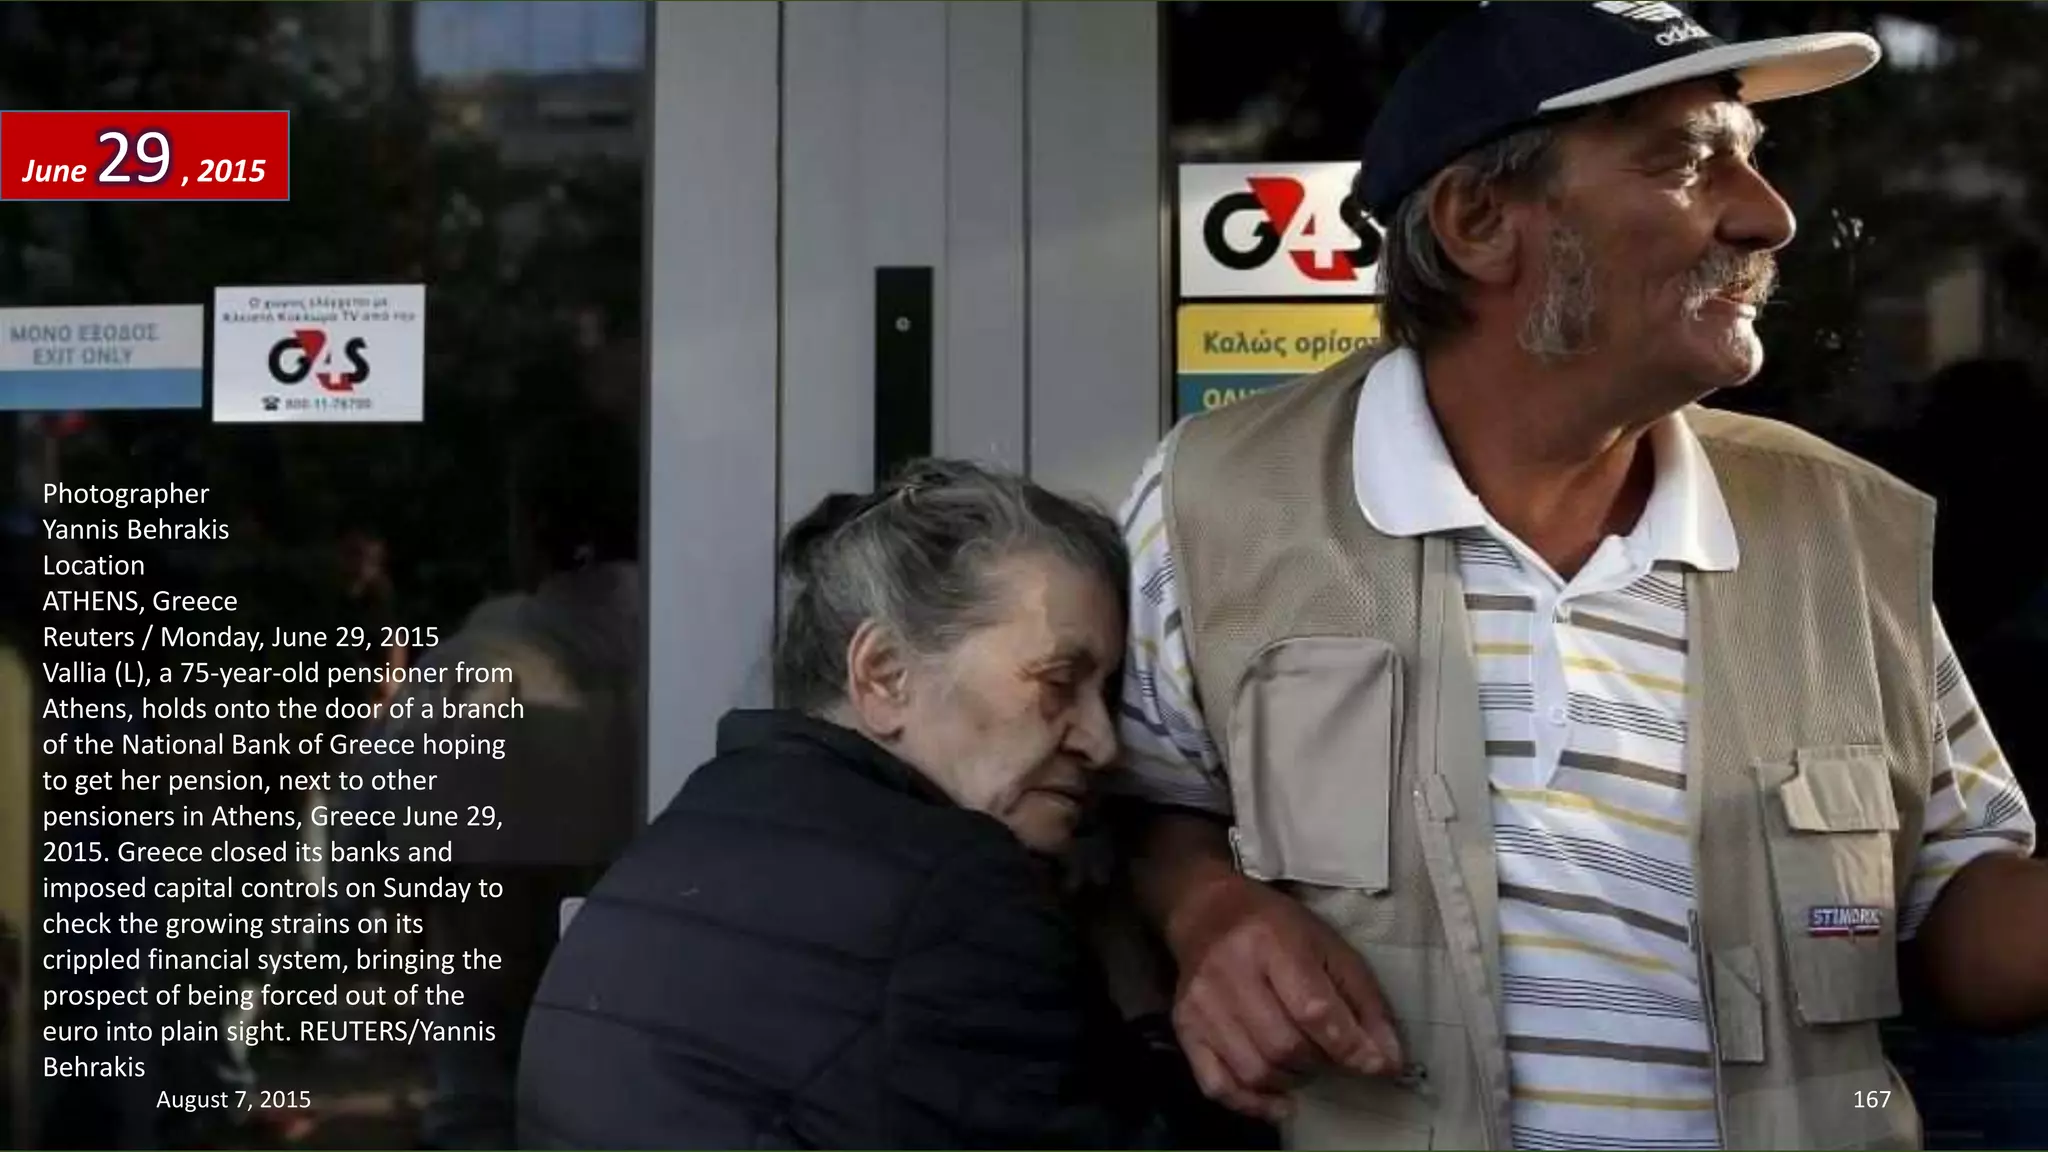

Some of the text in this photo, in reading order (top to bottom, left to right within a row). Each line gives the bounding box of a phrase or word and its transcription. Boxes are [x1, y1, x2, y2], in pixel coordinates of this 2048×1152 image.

[1203, 176, 1382, 281] G4S
[33, 345, 135, 365] EXIT ONLY
[268, 329, 370, 391] G4S
[1203, 329, 1287, 357] Καλώς
